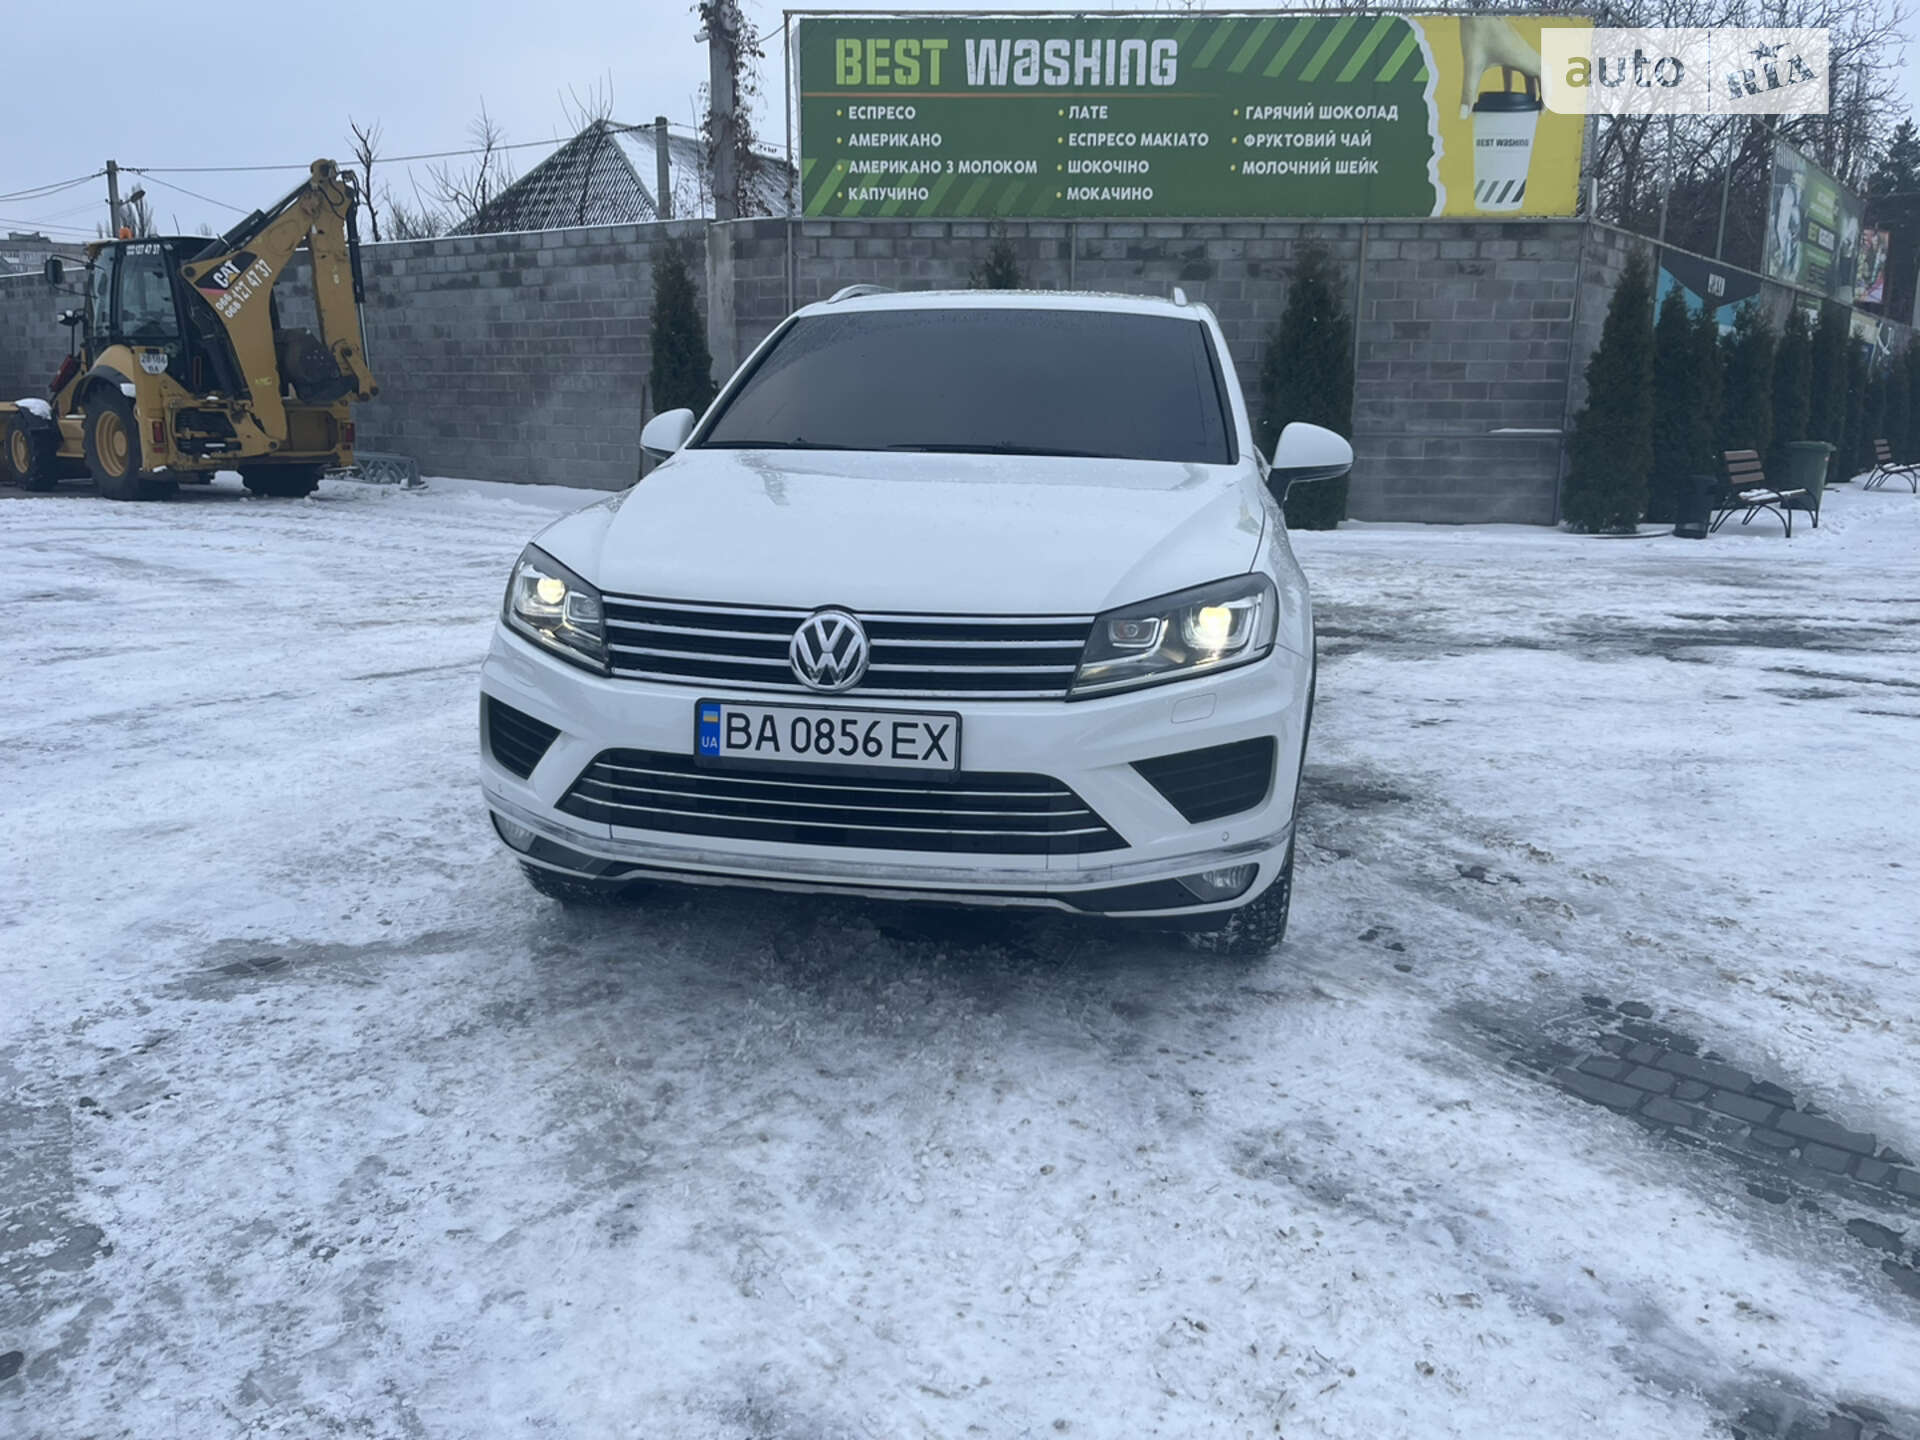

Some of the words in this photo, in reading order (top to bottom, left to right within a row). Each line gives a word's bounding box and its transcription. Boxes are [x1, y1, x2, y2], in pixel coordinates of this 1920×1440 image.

[836, 38, 948, 86] BEST
[848, 106, 916, 120] ЕСПРЕСО
[1068, 106, 1108, 120] ЛАТЕ
[1245, 104, 1315, 120] ГАРЯЧИЙ
[1319, 105, 1399, 121] ШОКОЛАД
[848, 133, 942, 147] АМЕРИКАНО
[1068, 133, 1136, 147] ЕСПРЕСО
[1140, 133, 1209, 147] МАКІАТО
[1244, 131, 1336, 147] ФРУКТОВИЙ
[1340, 131, 1372, 147] ЧАЙ
[848, 160, 942, 174] АМЕРИКАНО
[958, 160, 1038, 174] МОЛОКОМ
[1068, 160, 1149, 174] ШОКОЧІНО
[1242, 158, 1332, 175] МОЛОЧНИЙ
[1335, 158, 1379, 174] ШЕЙК
[848, 187, 929, 201] КАПУЧИНО
[1067, 187, 1153, 201] МОКАЧИНО
[213, 260, 241, 288] CAT
[246, 270, 263, 287] 47
[255, 259, 272, 278] 37
[701, 736, 718, 749] UA
